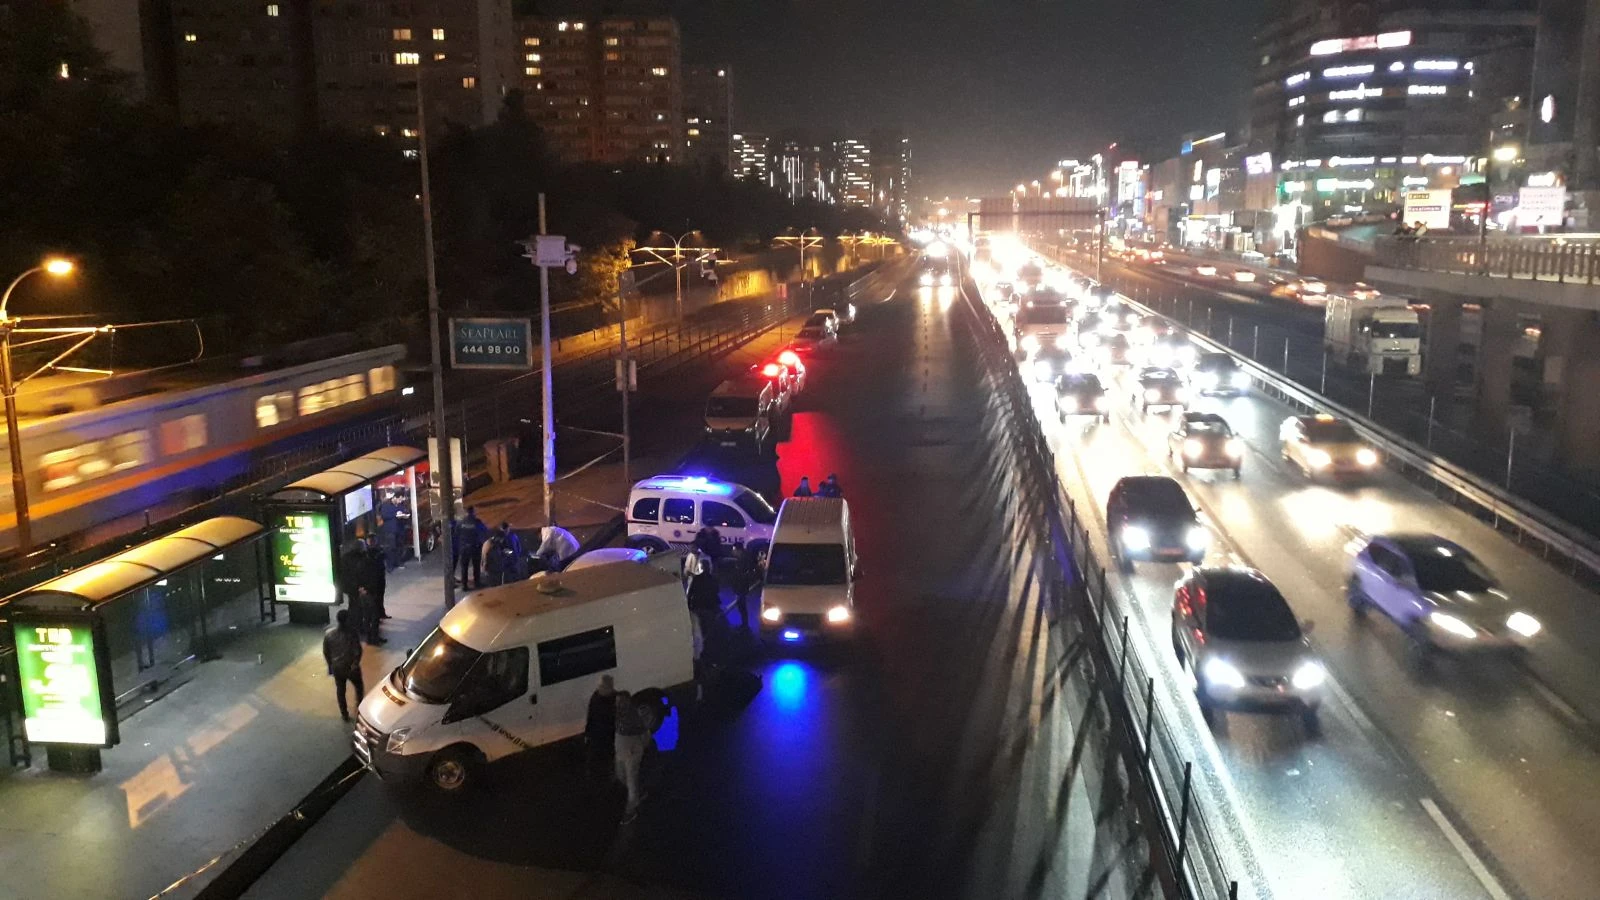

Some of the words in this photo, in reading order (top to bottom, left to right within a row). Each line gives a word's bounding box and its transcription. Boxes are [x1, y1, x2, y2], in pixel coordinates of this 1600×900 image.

[462, 345, 483, 353] 444
[487, 345, 501, 354] 98
[505, 345, 520, 354] 00
